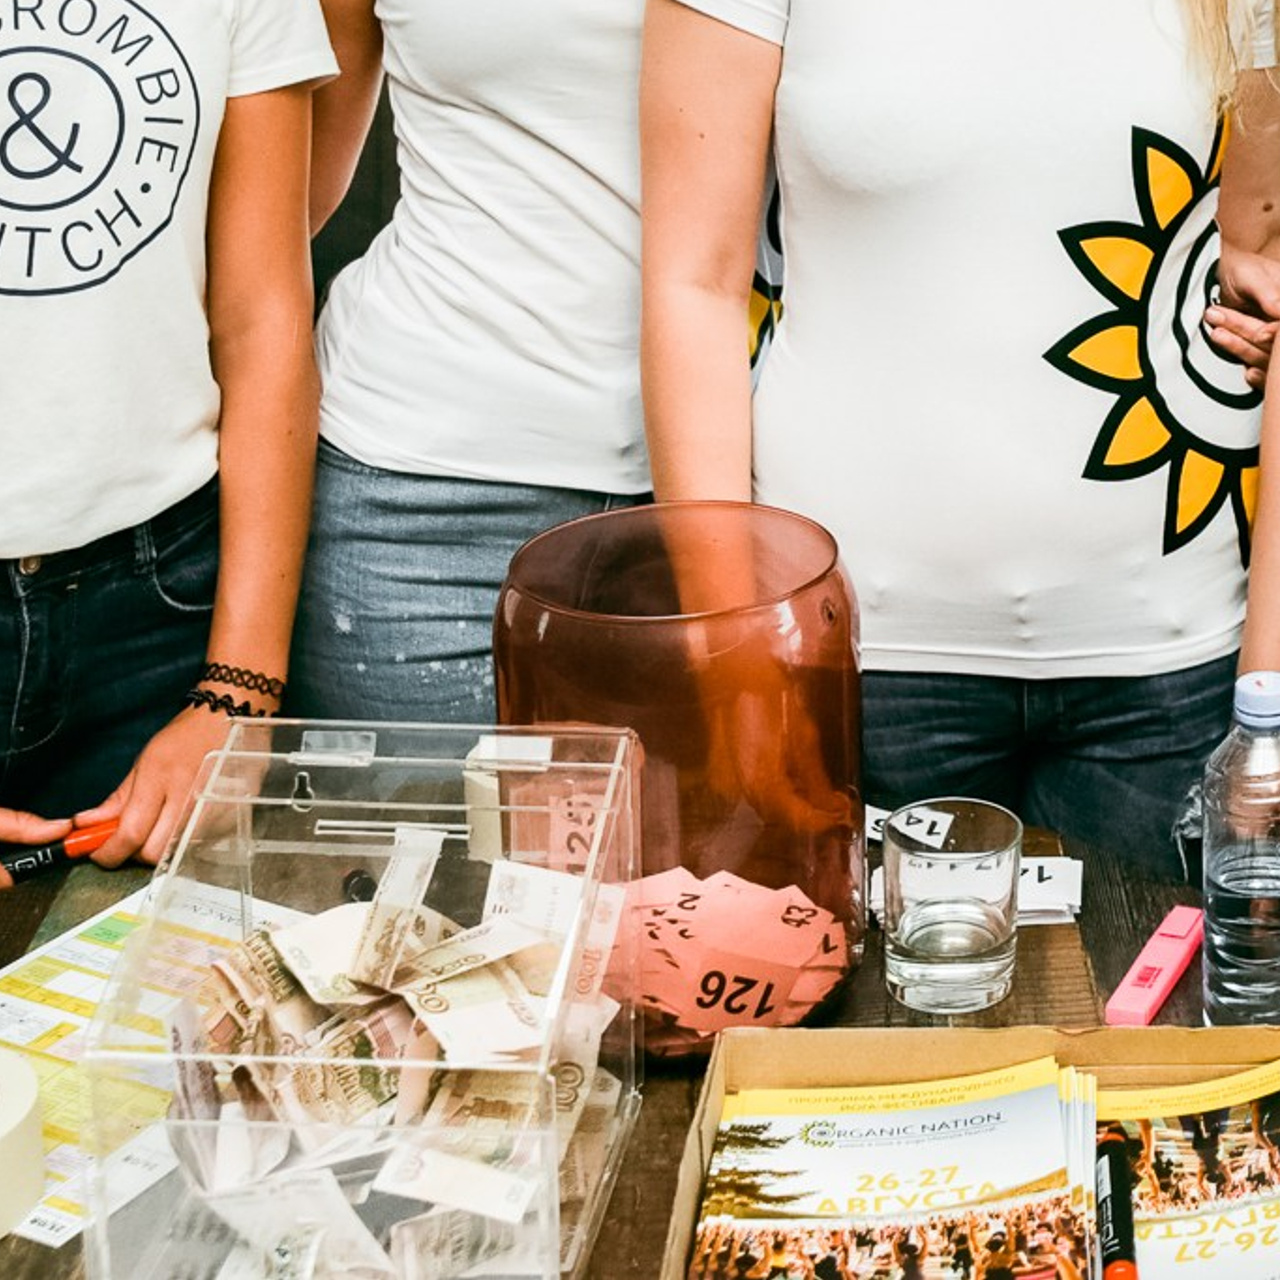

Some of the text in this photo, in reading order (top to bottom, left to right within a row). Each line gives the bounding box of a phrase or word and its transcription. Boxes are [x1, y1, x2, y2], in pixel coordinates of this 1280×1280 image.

[696, 970, 776, 1019] 126
[788, 1093, 876, 1104] ПРОГРАММА
[920, 1112, 1003, 1134] NATION
[855, 1165, 959, 1192] 26-27
[816, 1181, 1000, 1213] АВГУСТА
[1174, 1224, 1279, 1264] 26-27
